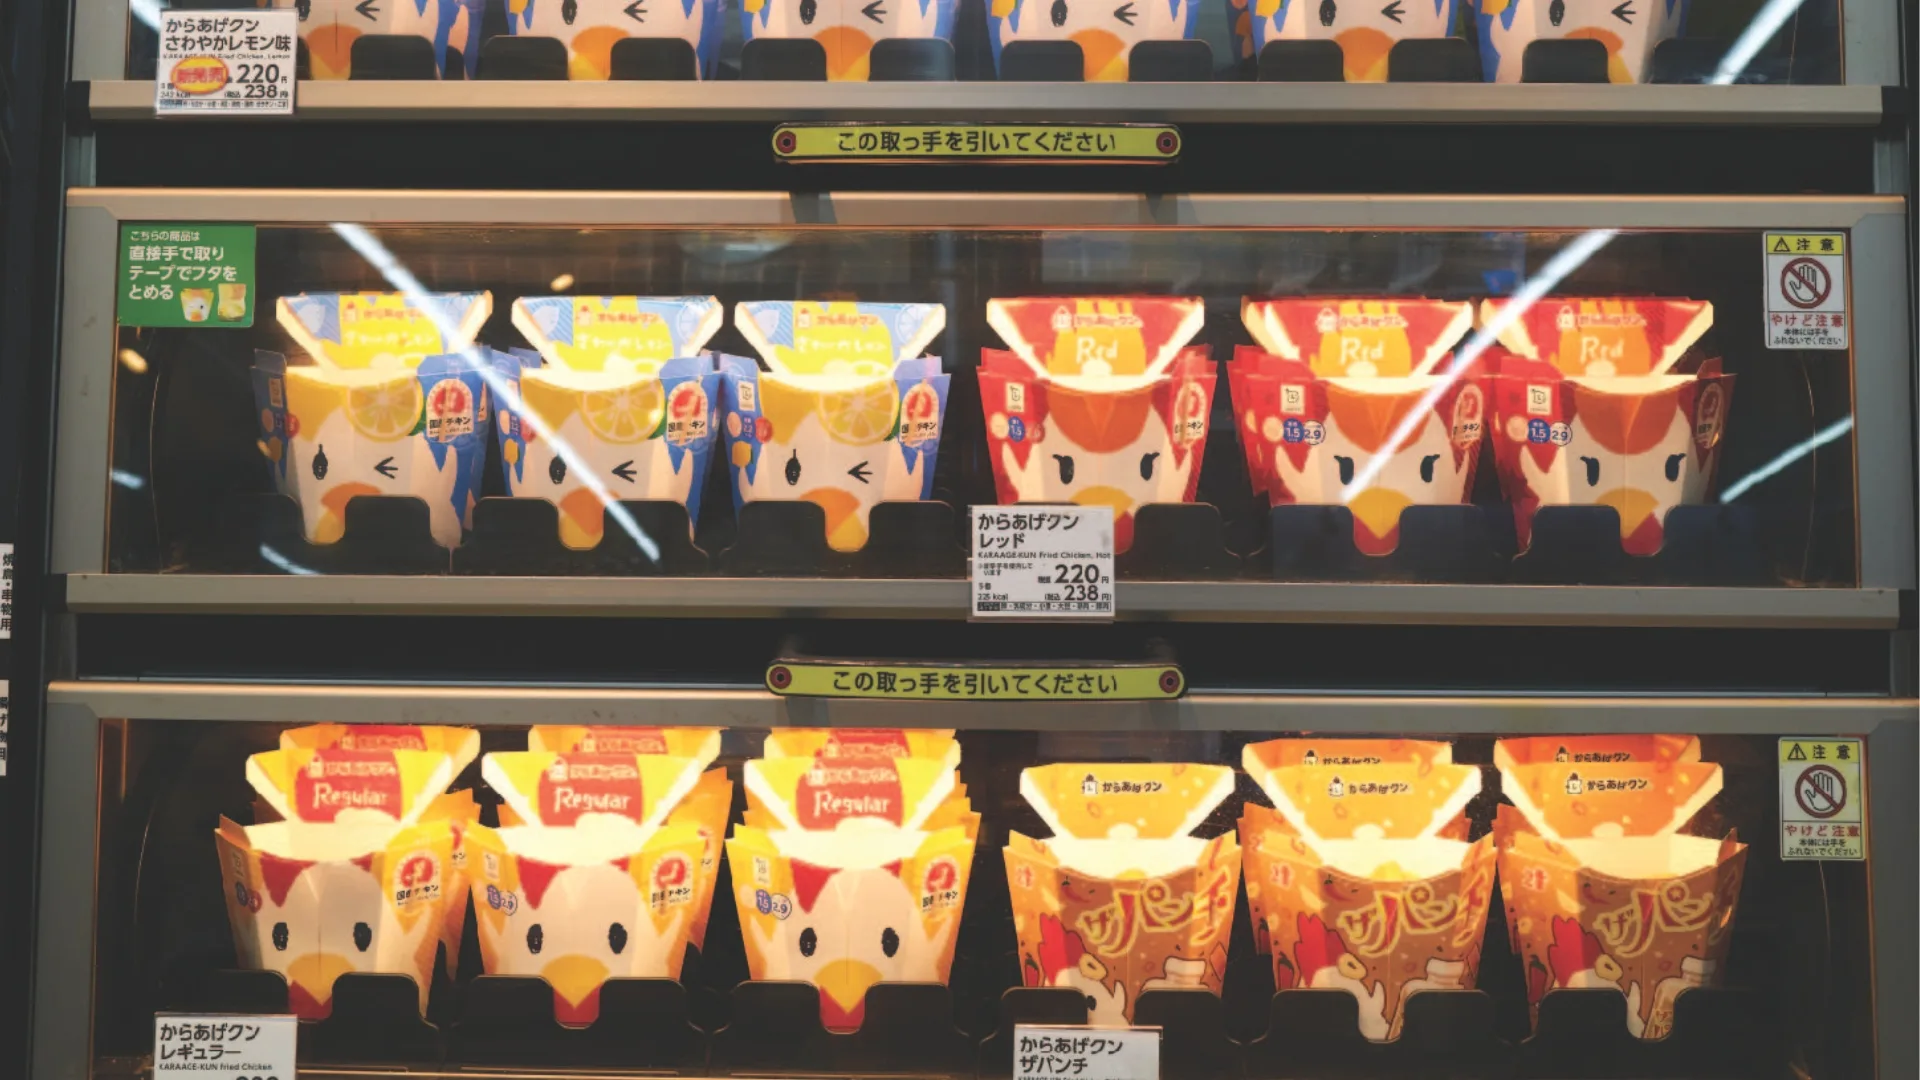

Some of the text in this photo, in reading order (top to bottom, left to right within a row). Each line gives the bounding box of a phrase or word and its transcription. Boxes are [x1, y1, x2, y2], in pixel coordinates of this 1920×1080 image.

[166, 17, 260, 33] からあげクン
[165, 34, 292, 52] さわやかレモン味
[236, 63, 280, 84] 220
[244, 84, 278, 99] 238
[837, 131, 1117, 154] この取っ手を引いてください
[130, 230, 201, 242] こちらの商品は
[1796, 237, 1835, 251] 注意
[129, 245, 225, 262] 直接手で取り
[129, 264, 238, 282] テープでフタを
[128, 283, 174, 300] とめる
[1771, 313, 1844, 328] やけど注意
[1076, 335, 1118, 364] Red
[1340, 336, 1384, 365] Red
[1580, 335, 1625, 364] Red
[1286, 427, 1301, 438] 1.5
[1304, 429, 1321, 440] 2.9
[1531, 427, 1547, 439] 1.5
[1552, 430, 1568, 441] 2.9
[977, 512, 1079, 531] からあげクン
[979, 532, 1025, 549] レッド
[1053, 563, 1100, 585] 220
[1101, 576, 1110, 584] 円
[1063, 584, 1099, 602] 238
[832, 670, 1118, 695] この取っ手を引いてください
[1812, 743, 1851, 760] 注意
[312, 782, 390, 809] Regular
[553, 786, 631, 813] Regular
[813, 790, 892, 818] Regular
[1784, 824, 1861, 837] やけど注意
[772, 901, 788, 914] 2.9
[160, 1022, 261, 1042] からあげクン
[160, 1043, 243, 1061] レギュラー
[1019, 1035, 1124, 1055] からあげクン
[1019, 1055, 1089, 1075] ザパンチ
